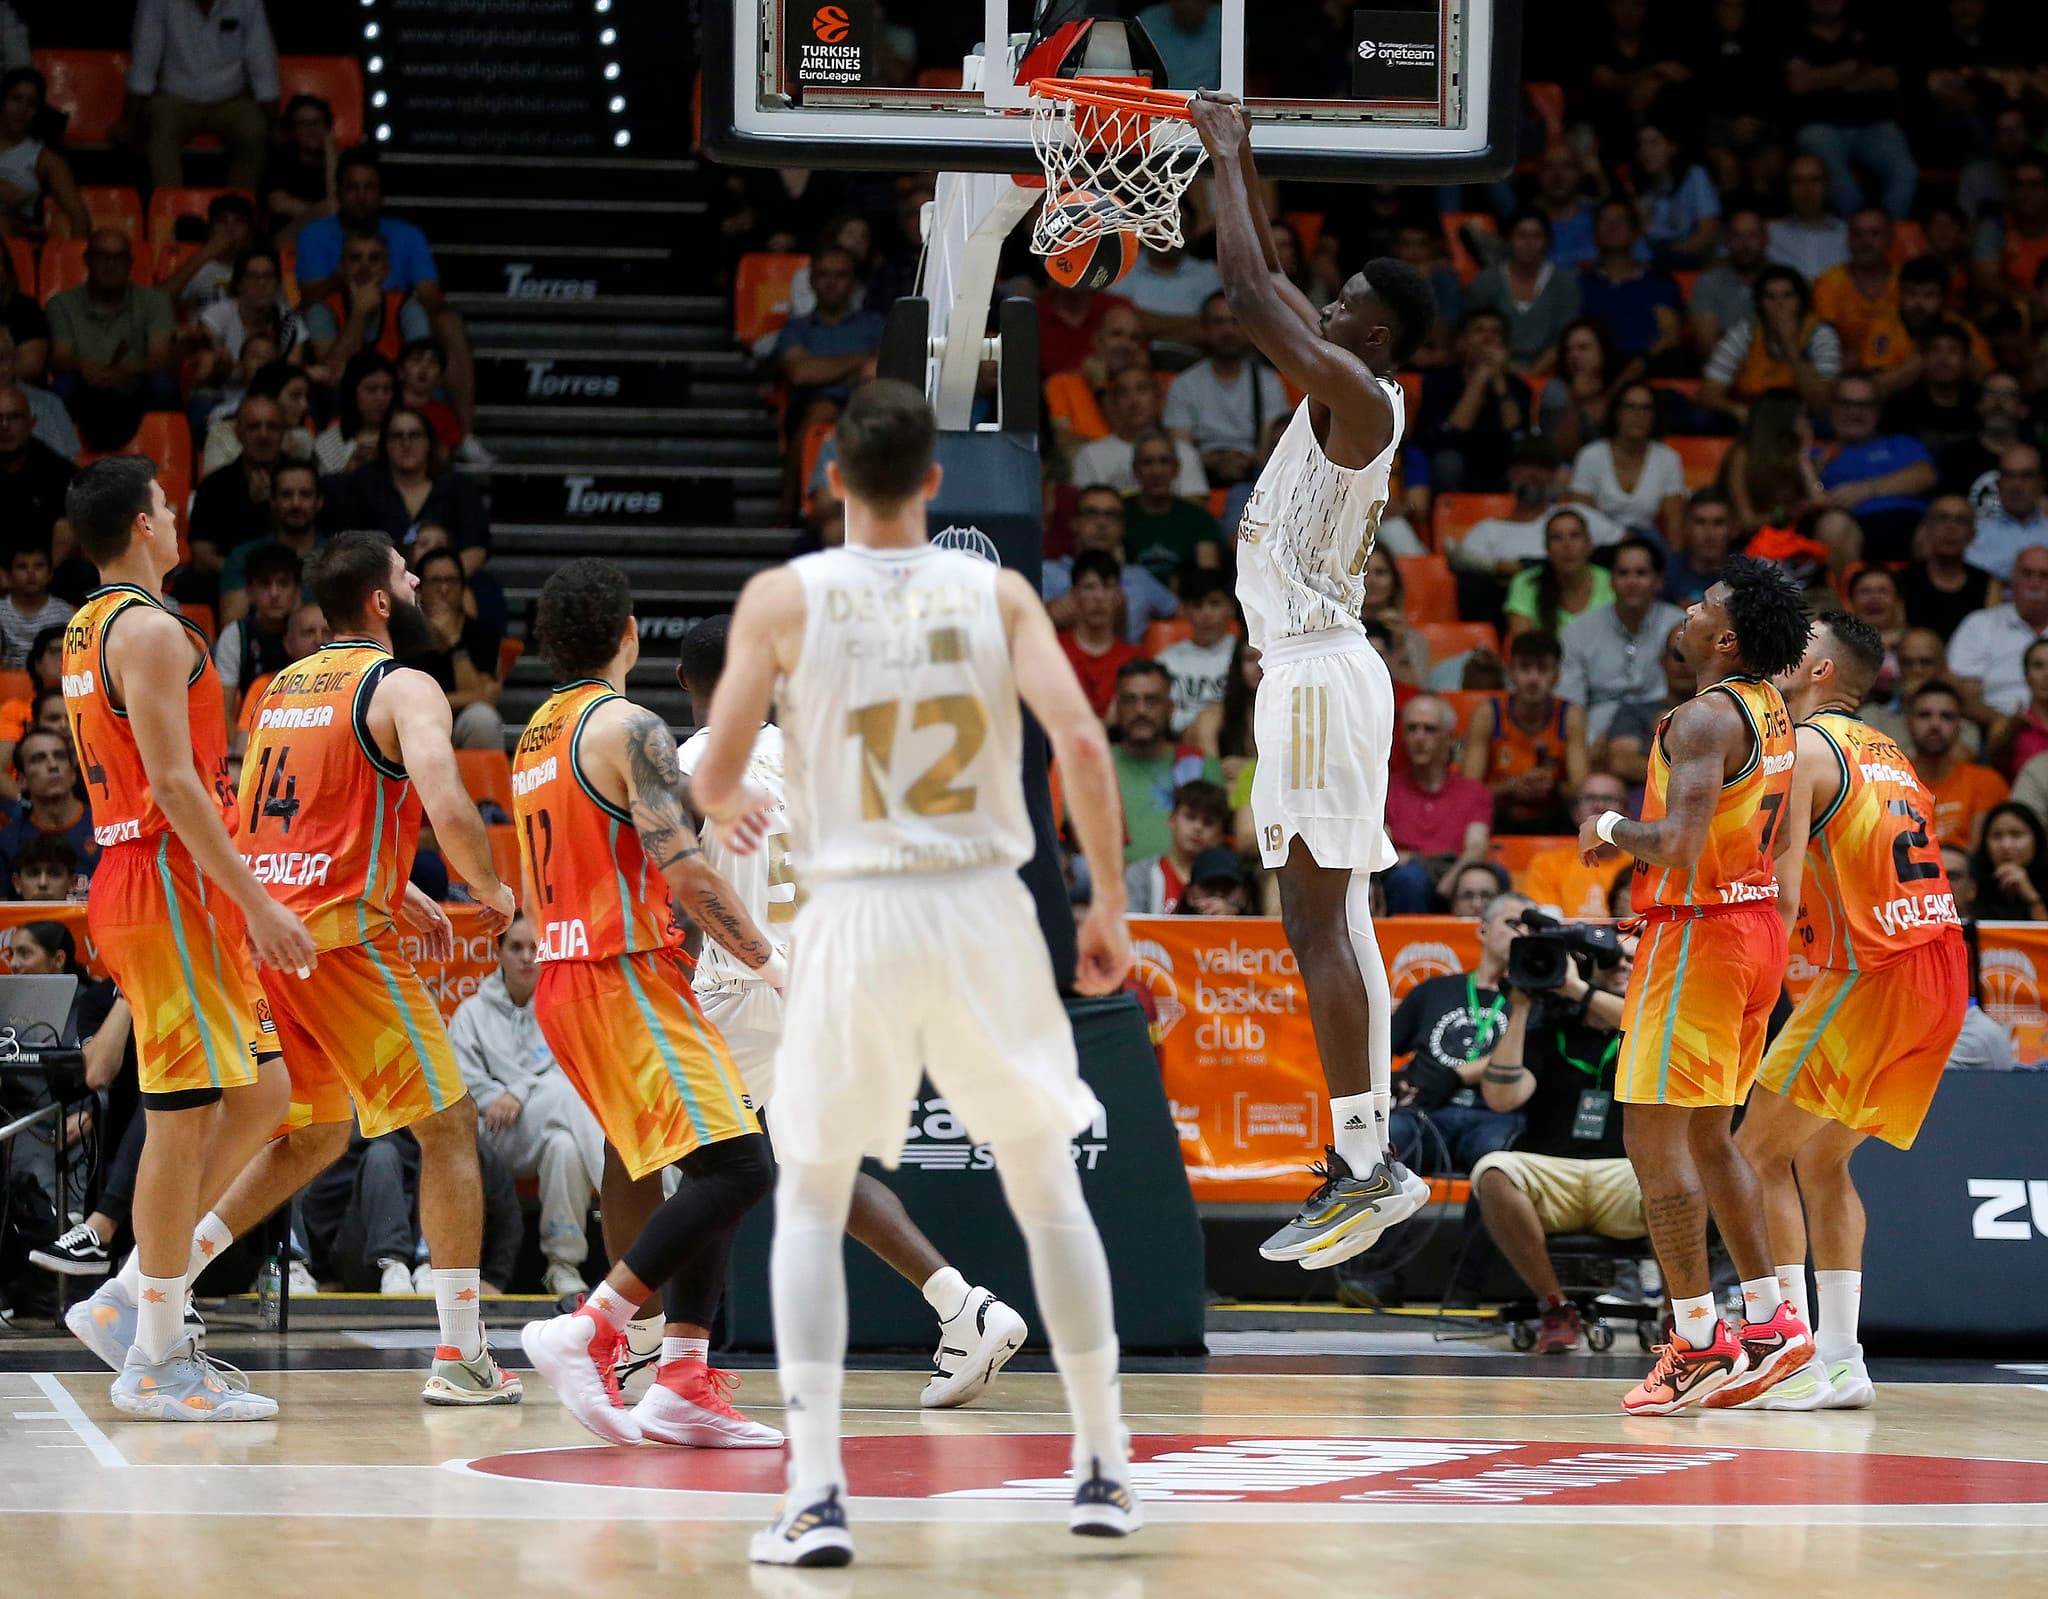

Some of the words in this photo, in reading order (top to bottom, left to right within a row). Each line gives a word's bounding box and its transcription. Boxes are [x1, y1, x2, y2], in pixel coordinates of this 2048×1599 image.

[800, 57, 861, 70] AIRLINES
[801, 45, 860, 57] TURKISH
[1378, 48, 1435, 59] oneteam
[799, 69, 861, 83] EuroLeague
[504, 263, 597, 299] Torres
[525, 361, 620, 397] Torres
[563, 474, 663, 514] Torres
[258, 705, 334, 731] PAMESA
[844, 692, 990, 821] 12
[250, 746, 300, 834] 14
[1263, 823, 1284, 852] 19
[1758, 792, 1785, 854] 7
[1887, 799, 1940, 883] 2
[1194, 938, 1301, 975] valenc
[1195, 978, 1298, 1014] basket
[1195, 1016, 1266, 1051] club
